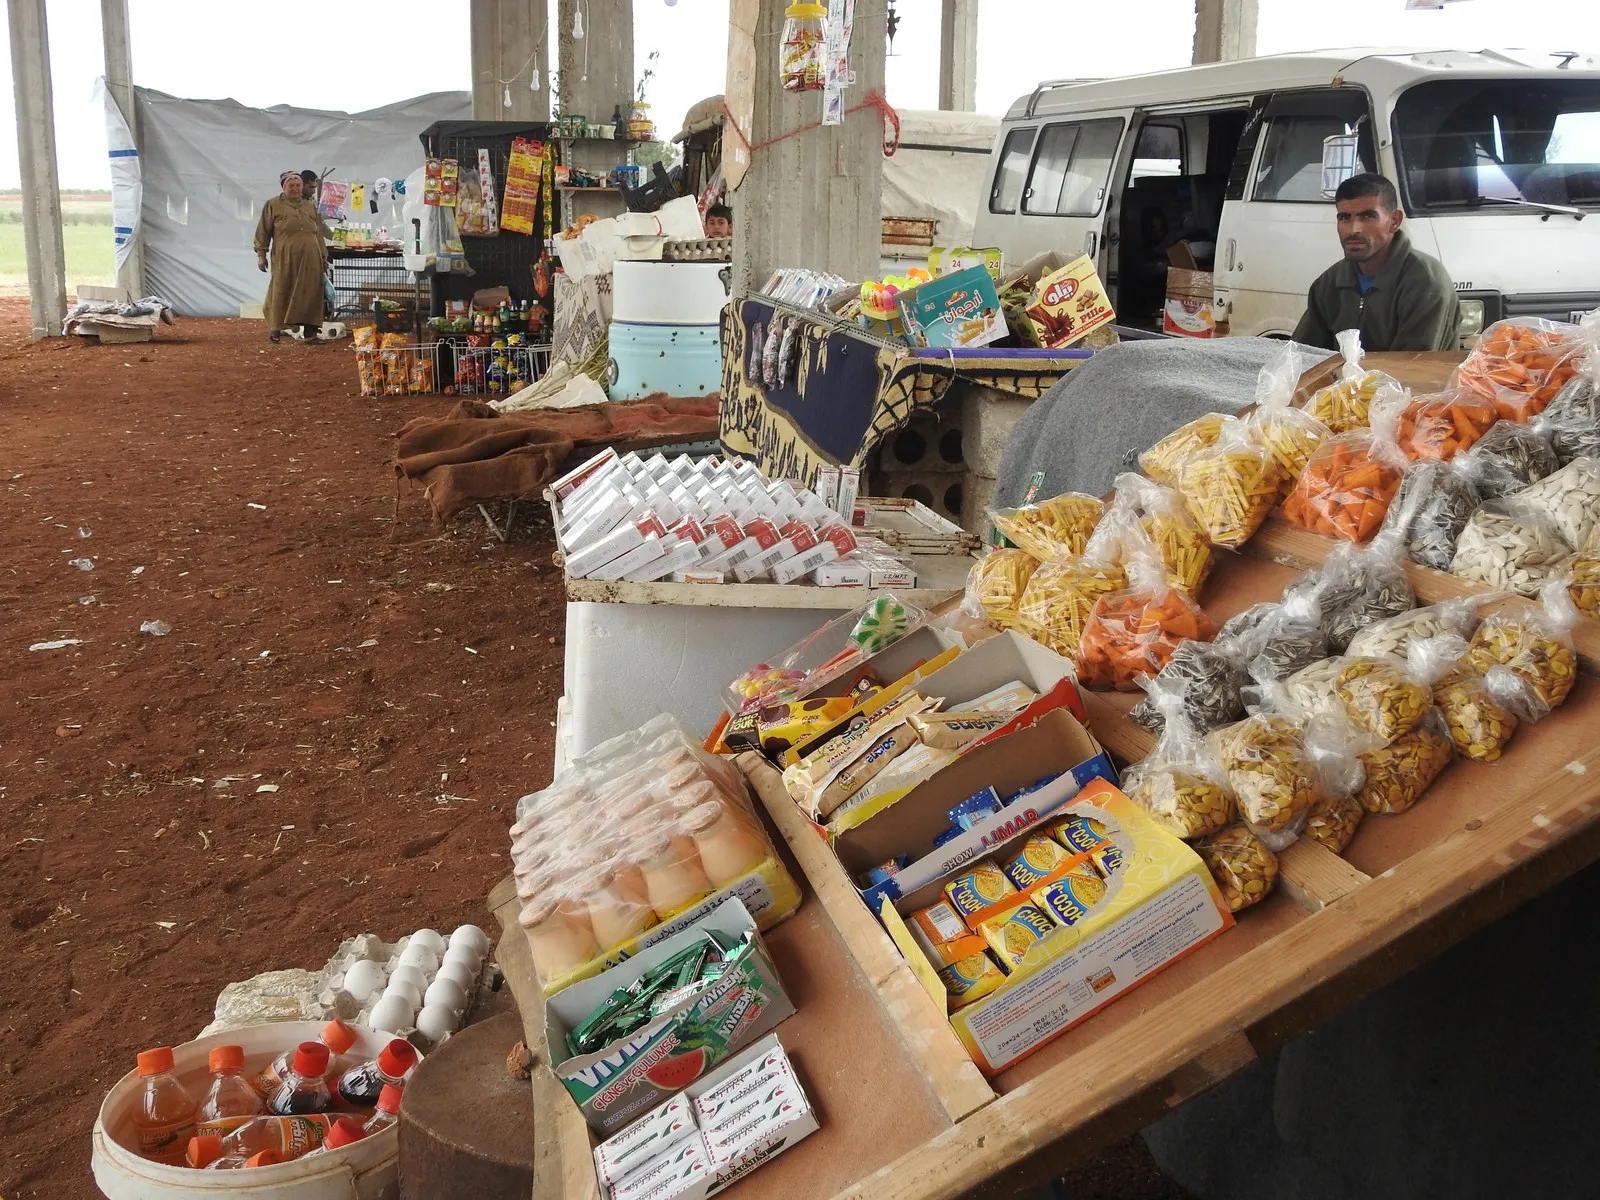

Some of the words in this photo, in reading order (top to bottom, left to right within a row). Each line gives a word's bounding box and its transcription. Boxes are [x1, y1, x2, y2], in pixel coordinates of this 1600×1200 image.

[1453, 280, 1472, 289] onn
[943, 289, 984, 324] أرجوان
[826, 746, 851, 762] VANILLA
[981, 808, 1039, 849] LIMAR
[942, 847, 974, 872] SHOW
[677, 904, 712, 930] قاسيون
[645, 922, 678, 950] للألبان
[633, 1033, 682, 1080] GÜLÜMSE
[604, 1103, 636, 1128] KARPUZ
[718, 1150, 769, 1184] SPEARMINT
